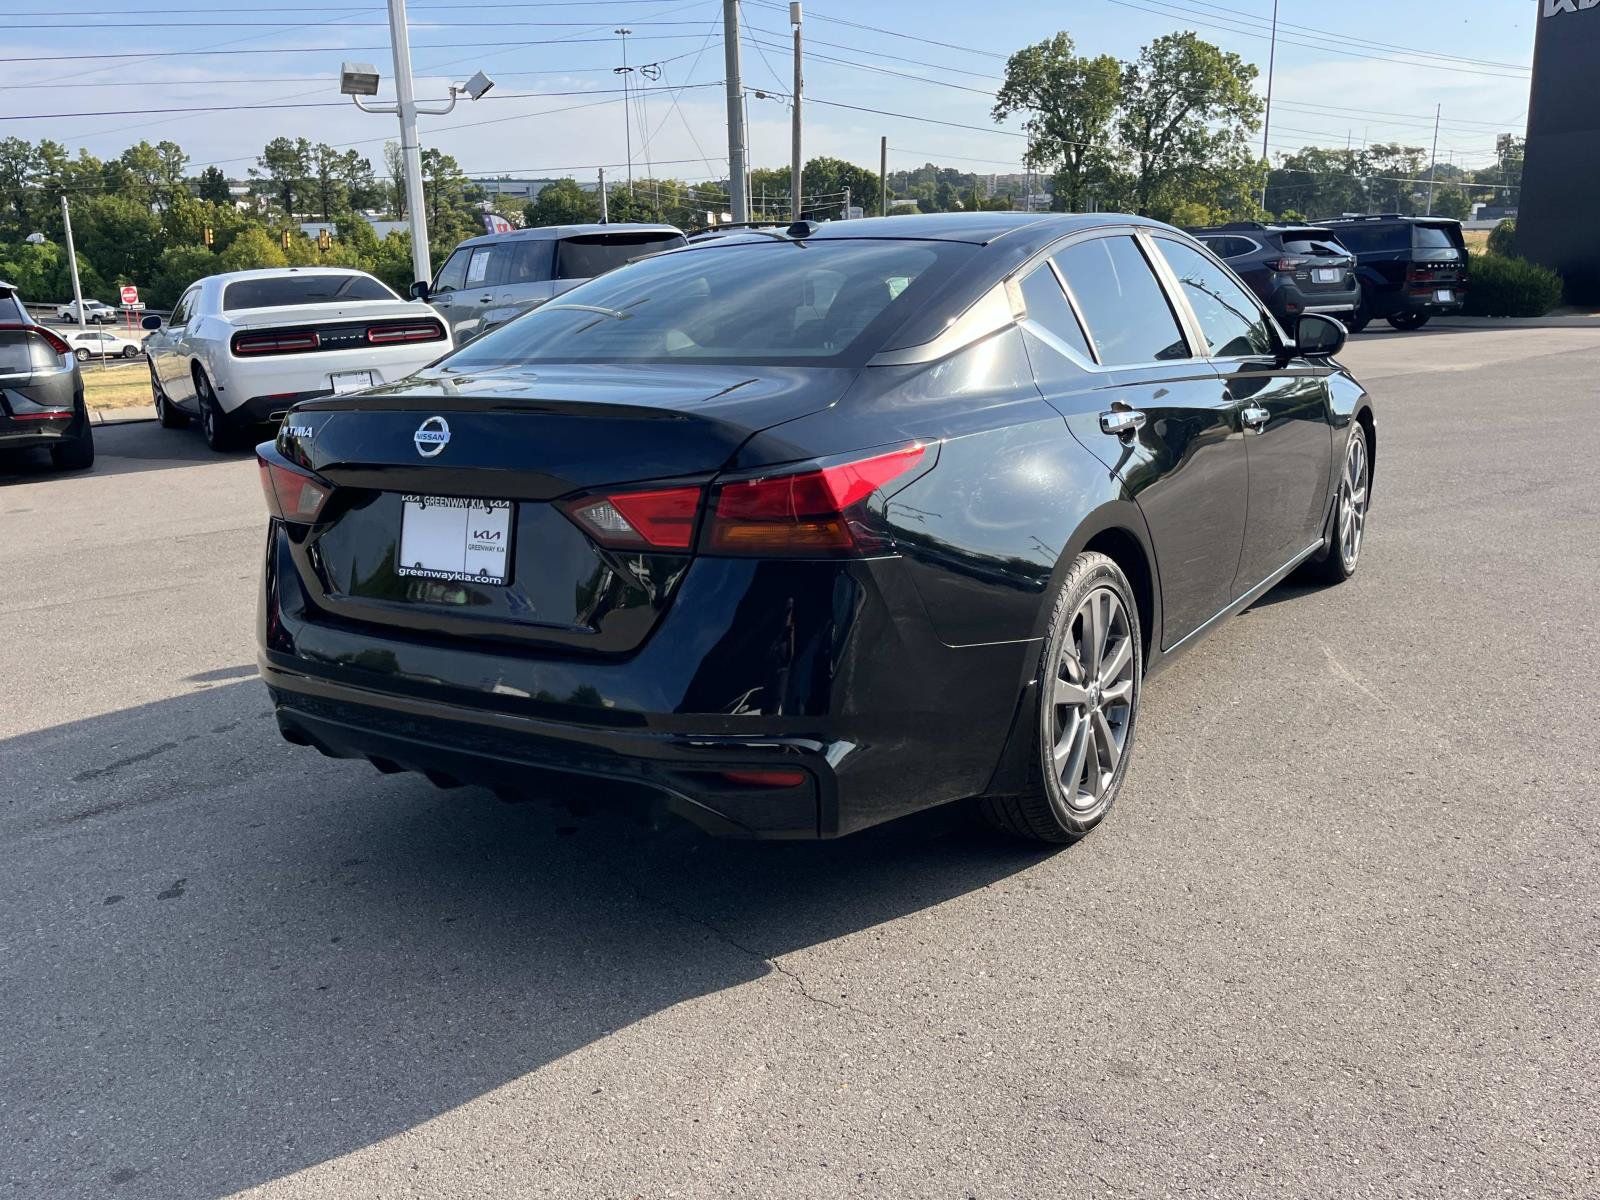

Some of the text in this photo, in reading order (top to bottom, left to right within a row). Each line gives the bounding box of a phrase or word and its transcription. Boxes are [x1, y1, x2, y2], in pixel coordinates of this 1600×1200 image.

[416, 433, 445, 441] NISSAN
[424, 496, 485, 509] GREENWAY KIA
[399, 568, 502, 584] greenwaykia.com
